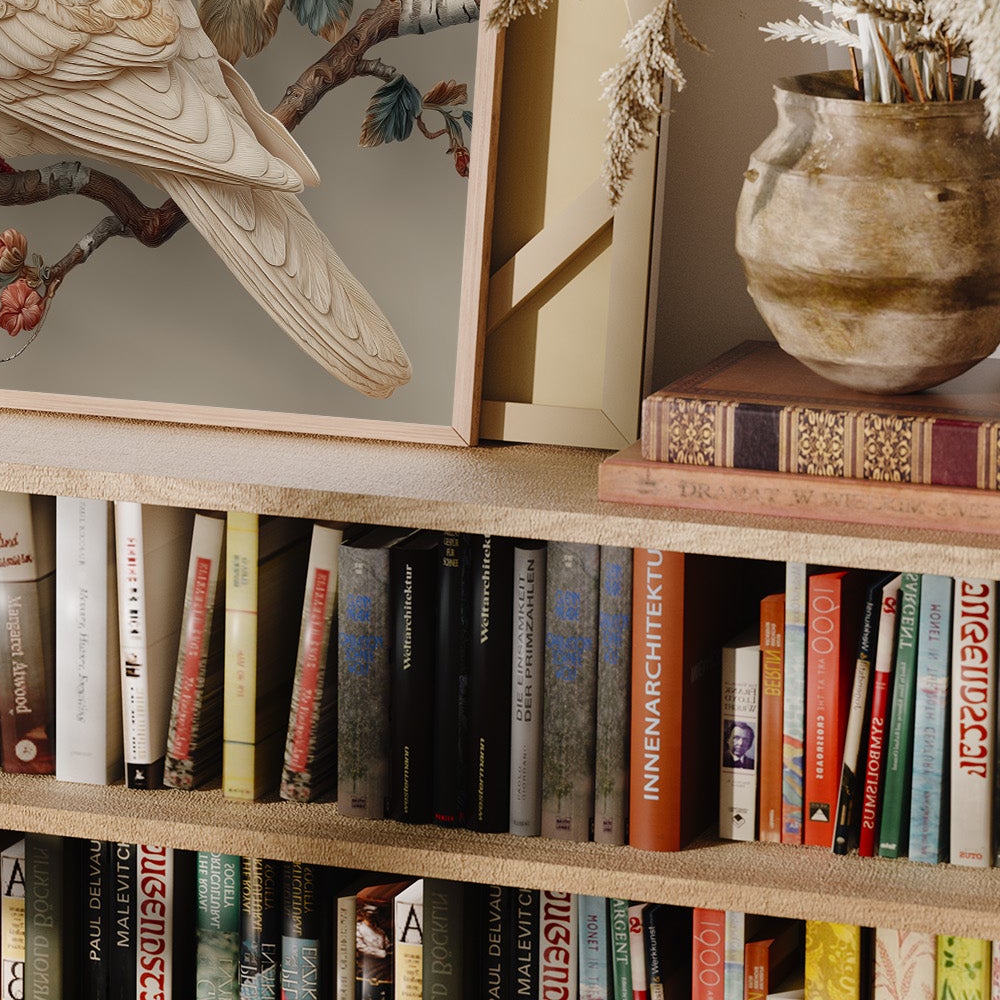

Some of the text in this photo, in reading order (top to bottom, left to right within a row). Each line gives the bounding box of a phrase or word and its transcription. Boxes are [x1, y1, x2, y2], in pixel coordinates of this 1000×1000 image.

[6, 594, 33, 714] Margaret Atwood
[402, 563, 414, 670] Weltarchitektur
[515, 573, 526, 722] DIE EINSAMKEIT
[524, 559, 535, 722] DER PRIMZAHLEN
[402, 745, 410, 814] westermann
[477, 737, 486, 822] westermann
[88, 916, 101, 962] PAUL
[587, 913, 598, 952] MONET
[648, 926, 660, 975] Werkkunst
[694, 921, 721, 988] 1900
